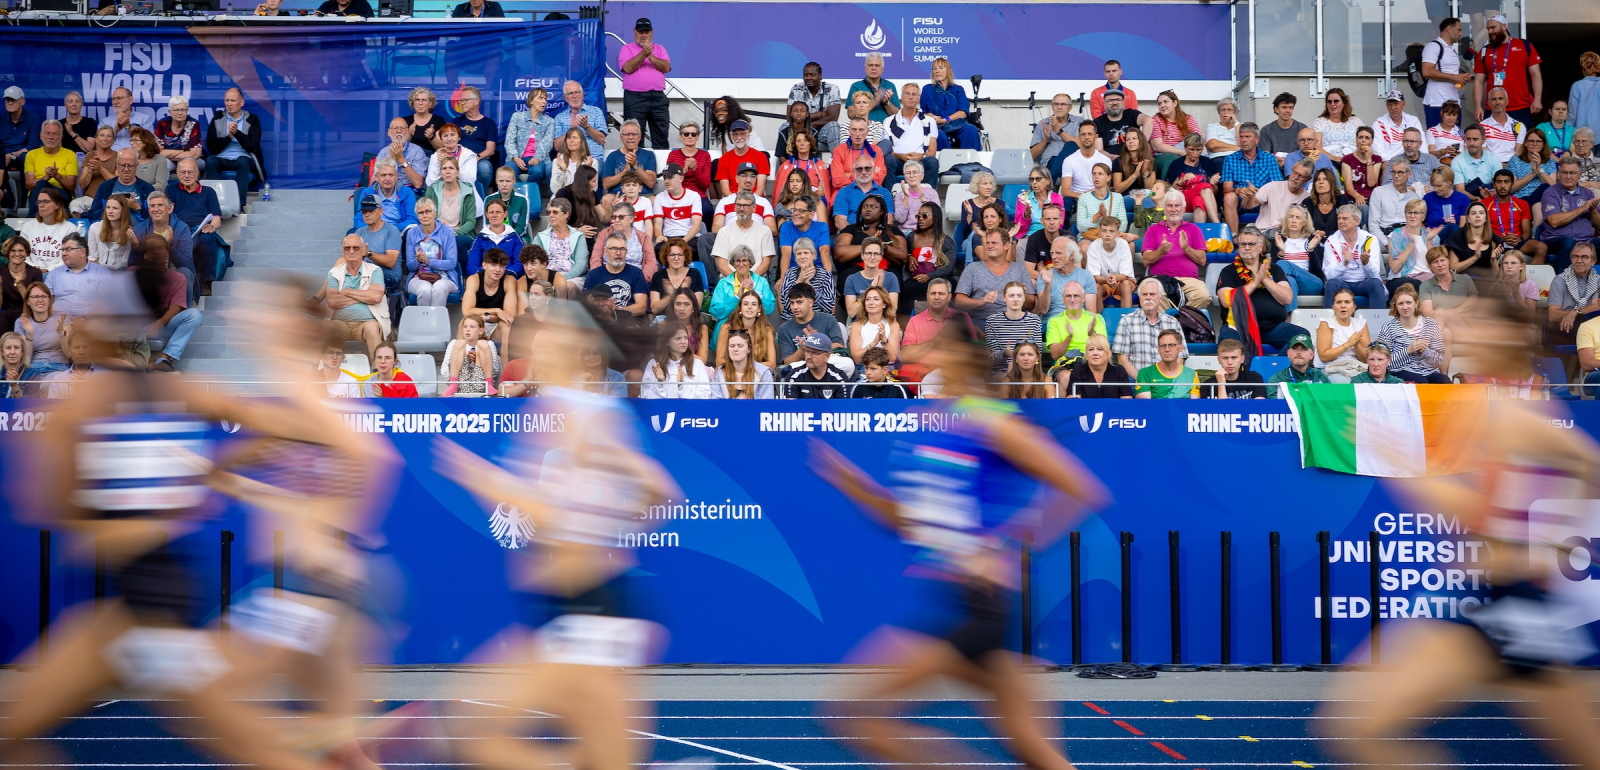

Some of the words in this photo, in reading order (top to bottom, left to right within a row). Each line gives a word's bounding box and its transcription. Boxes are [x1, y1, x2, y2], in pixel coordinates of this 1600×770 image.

[913, 17, 943, 25] FISU
[104, 42, 172, 72] FISU
[515, 79, 553, 88] FISU
[445, 413, 490, 433] 2025
[493, 413, 520, 433] FISU
[523, 413, 565, 433] GAMES
[681, 418, 719, 428] FISU
[760, 412, 871, 432] RHINE-RUHR
[874, 412, 919, 432] 2025
[922, 412, 948, 432] FISU
[1108, 418, 1147, 429] FISU
[1187, 413, 1298, 433] RHINE-RUHR
[630, 498, 762, 520] sministerium
[1374, 512, 1472, 535] GERM
[1315, 596, 1494, 619] EDERATIO
